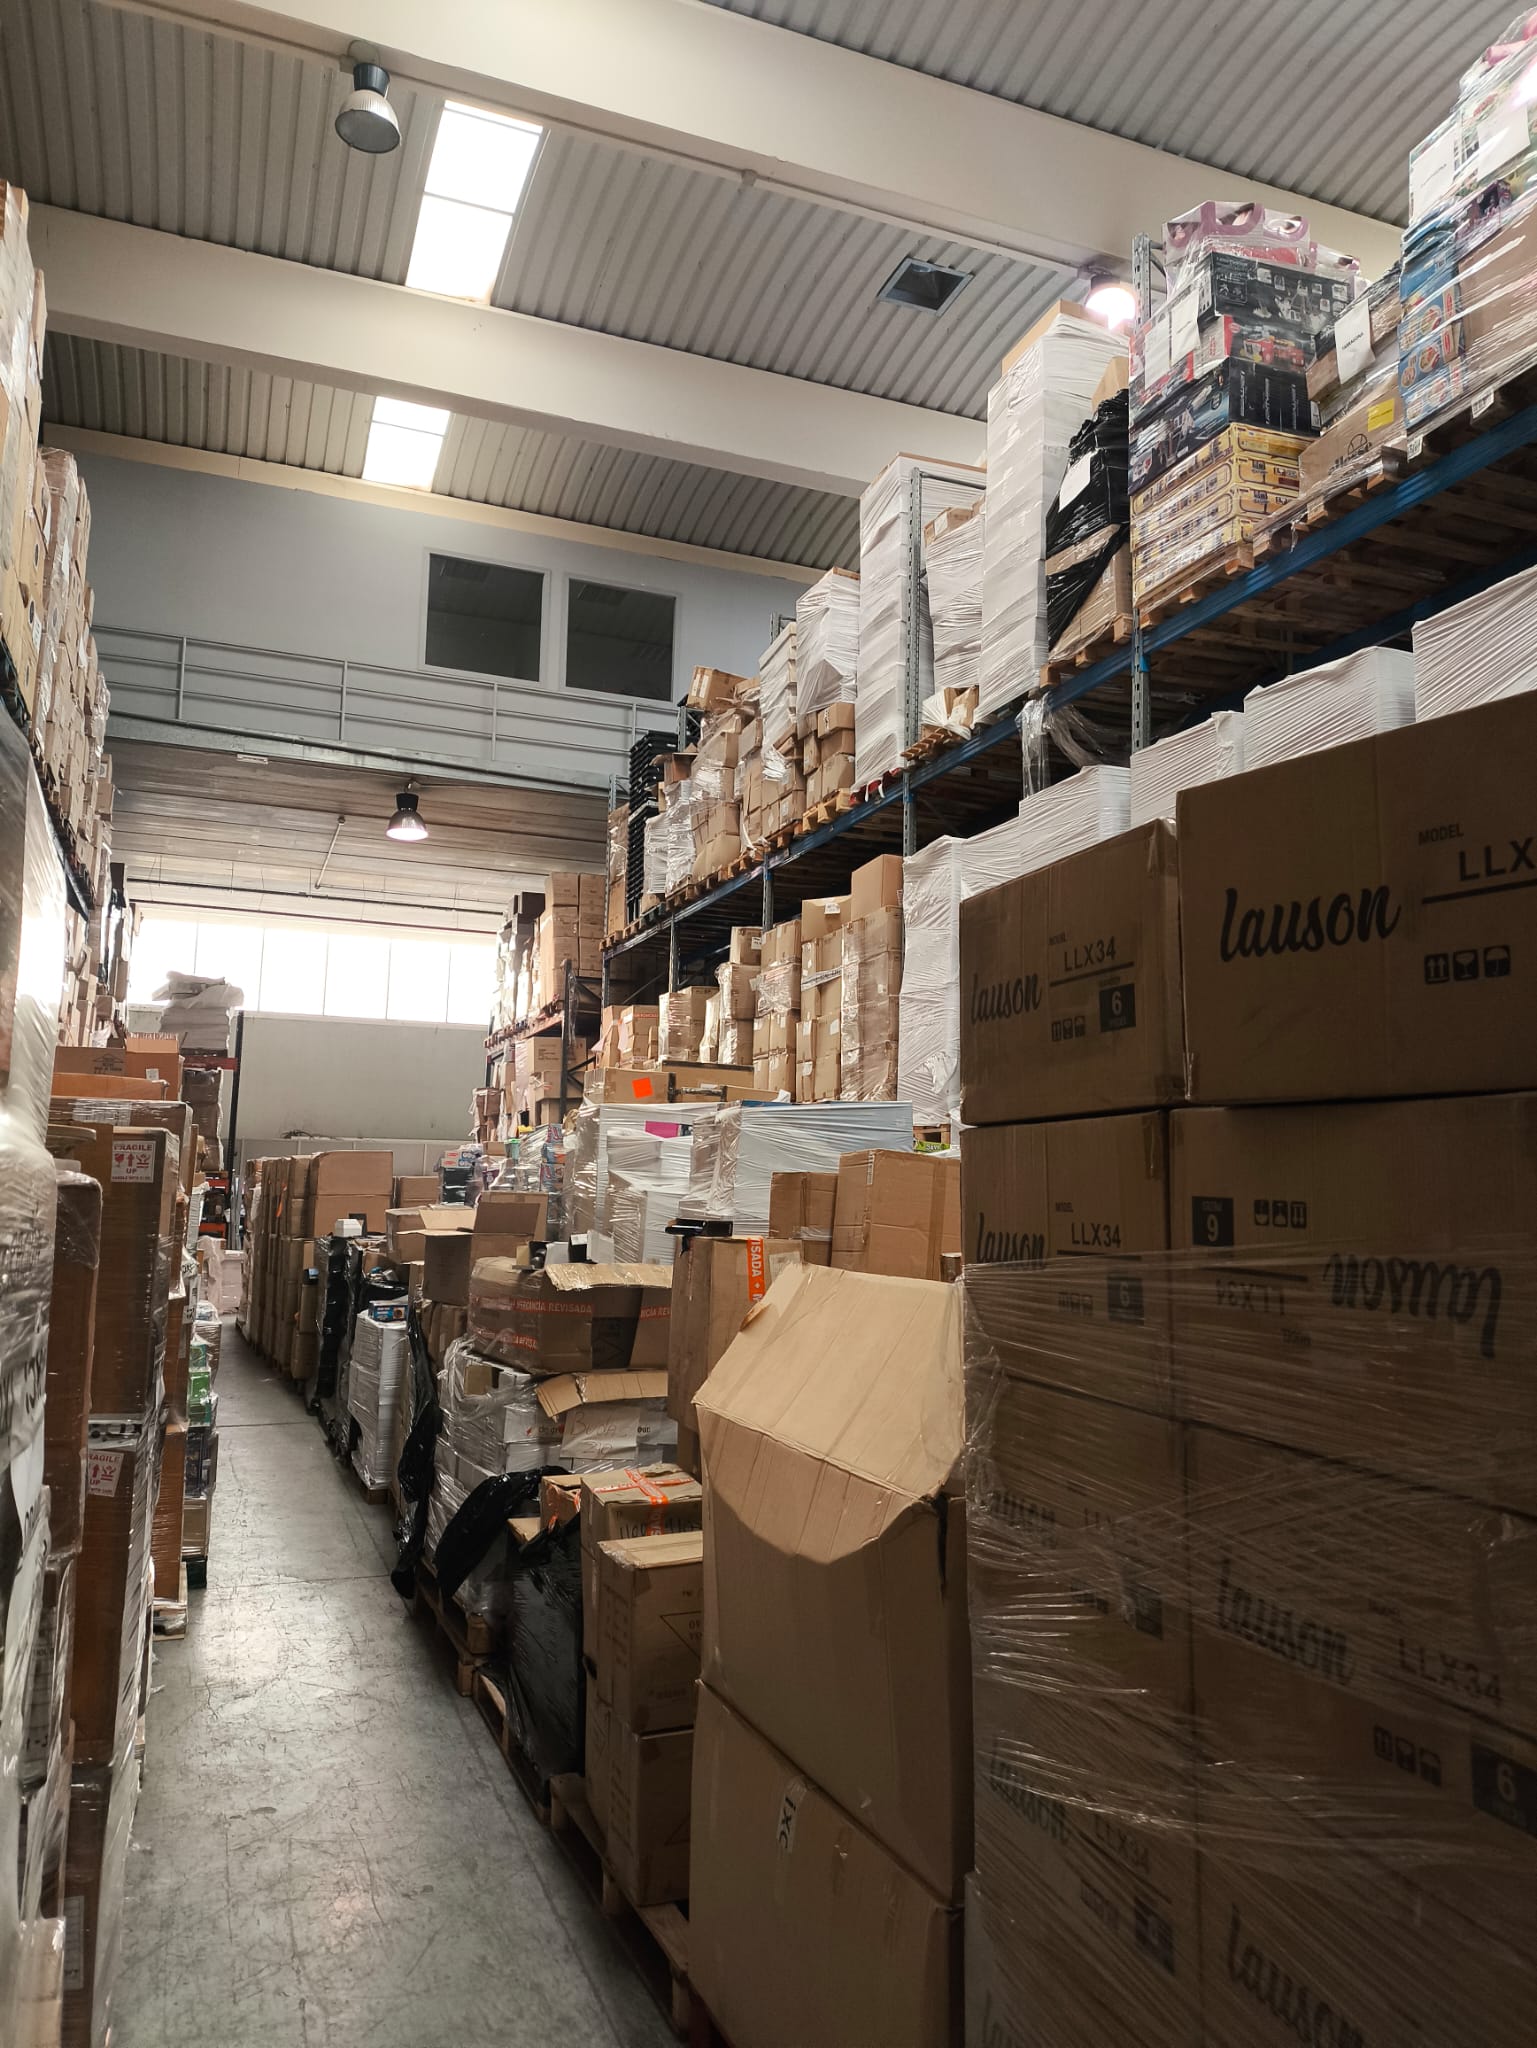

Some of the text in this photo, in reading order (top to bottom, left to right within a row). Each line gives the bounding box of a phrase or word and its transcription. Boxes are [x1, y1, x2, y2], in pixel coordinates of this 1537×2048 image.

[1418, 823, 1464, 846] MODEL
[1220, 885, 1400, 962] lauson
[1064, 936, 1116, 972] LLX34
[970, 972, 1042, 1025] lauson
[1111, 991, 1121, 1015] 6
[976, 1211, 1047, 1270] lauson
[1071, 1222, 1121, 1248] LLX34
[1323, 1252, 1504, 1360] lauson
[1217, 1558, 1354, 1688] lauson
[1399, 1638, 1503, 1705] LLX34
[1496, 1762, 1516, 1801] 6
